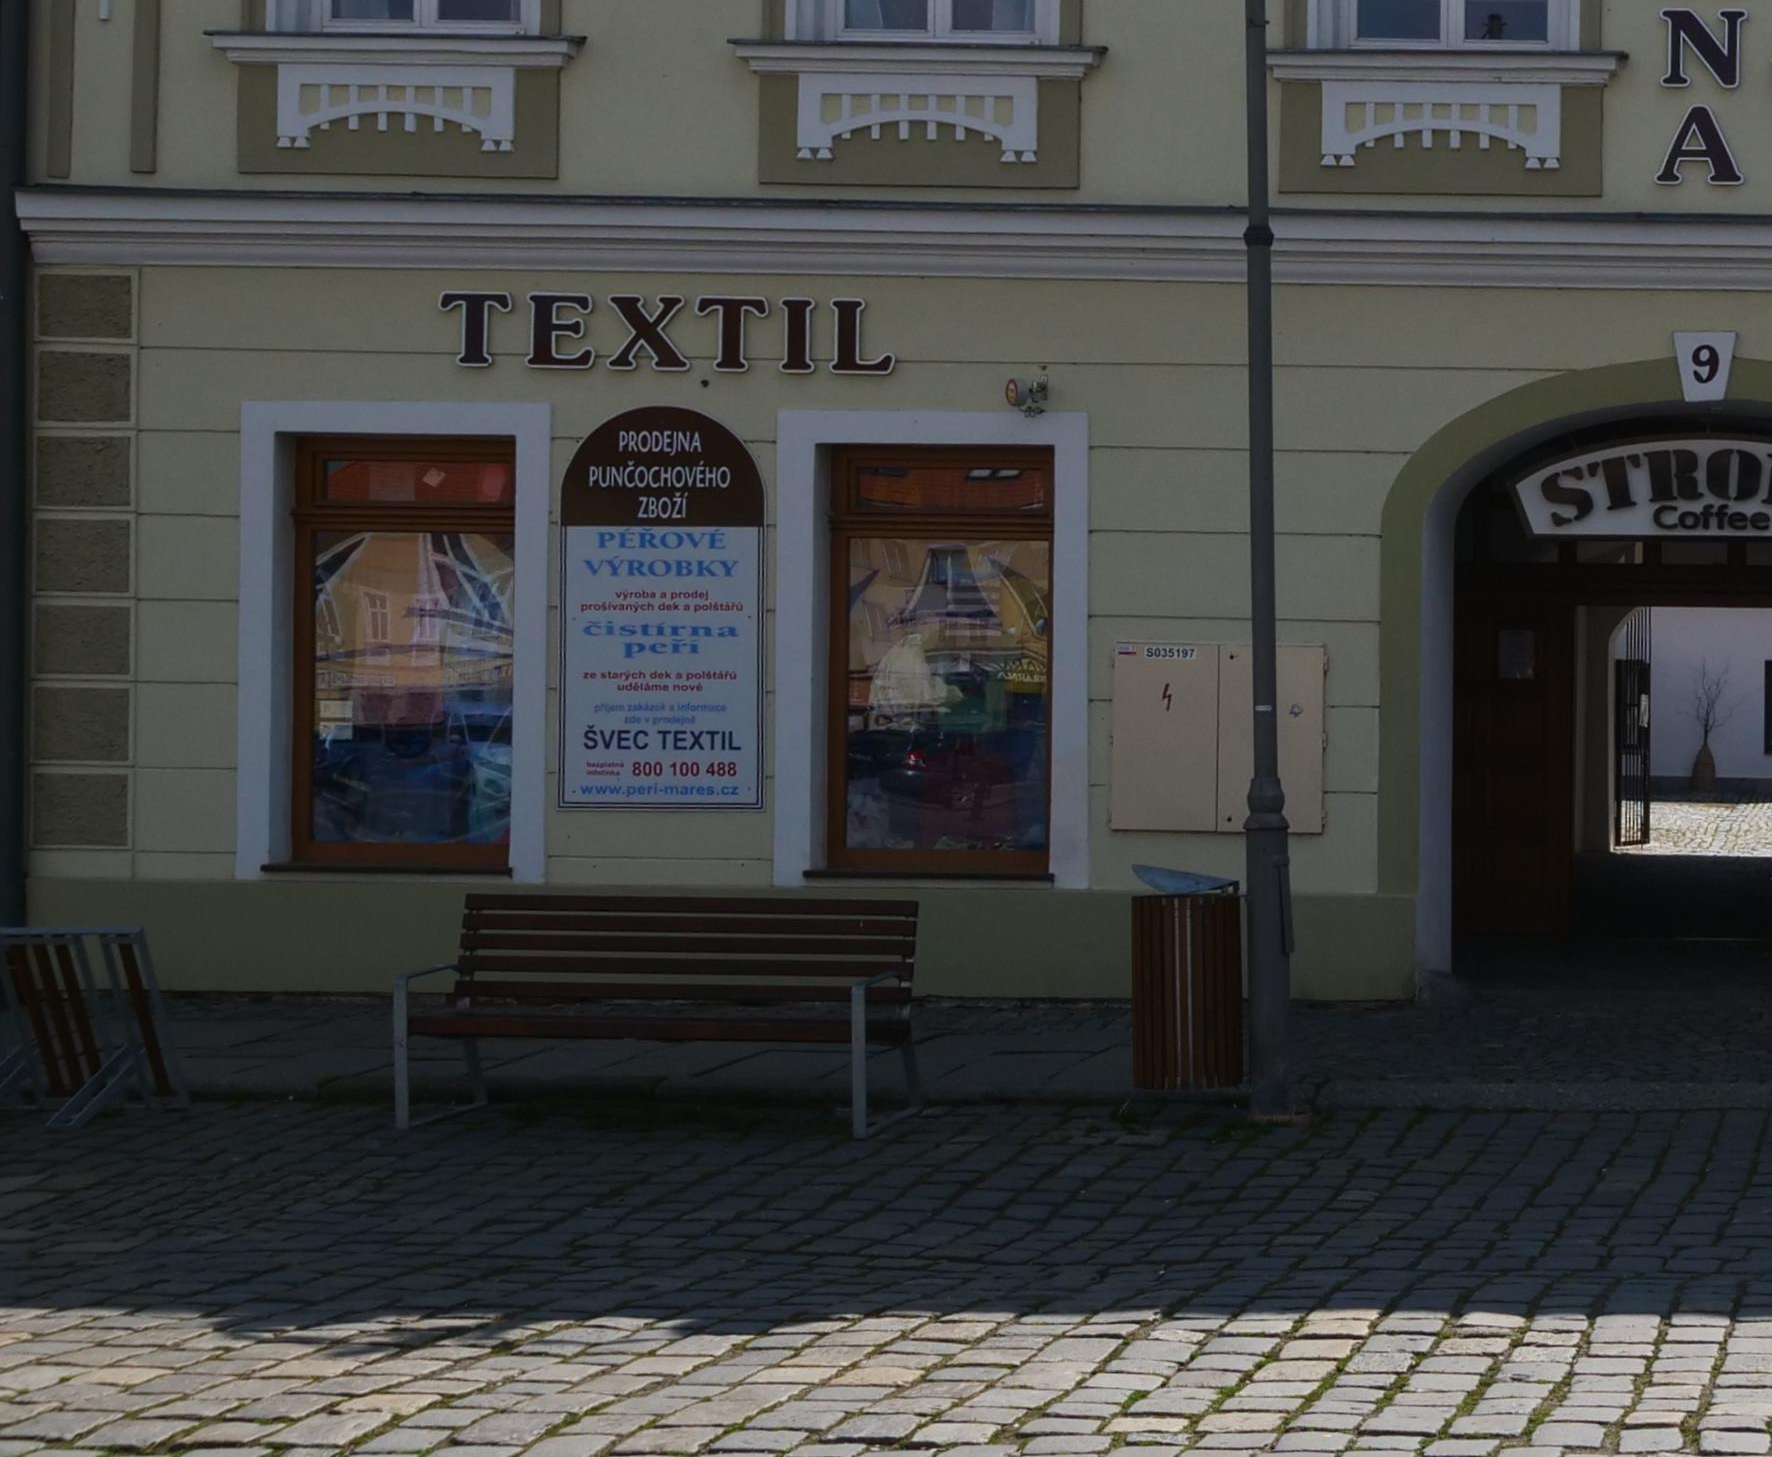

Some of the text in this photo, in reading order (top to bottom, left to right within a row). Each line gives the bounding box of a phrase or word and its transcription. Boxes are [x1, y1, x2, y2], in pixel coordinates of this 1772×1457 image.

[438, 290, 896, 376] TEXTIL
[1691, 343, 1720, 385] 9
[618, 430, 702, 457] PRODEJNA
[588, 461, 731, 488] PUNČOCHOVÉHO
[637, 493, 687, 519] ZBOŽÍ
[1653, 503, 1771, 532] Coffee
[596, 528, 727, 550] PÉŘOVÉ
[582, 555, 739, 578] VÝROBKY
[615, 589, 656, 601] výroba
[671, 589, 709, 601] prodej
[580, 601, 654, 614] prošívaných
[658, 602, 680, 612] dek
[693, 601, 743, 614] polštářů
[582, 620, 739, 638] čistírna
[624, 638, 700, 659] peří
[1146, 647, 1195, 659] S035197
[583, 672, 597, 680] ze
[600, 670, 646, 682] starých
[649, 670, 672, 680] dek
[686, 669, 737, 682] polštářů
[617, 681, 703, 692] uděláme nové
[583, 725, 742, 751] ŠVEC TEXTIL
[632, 761, 737, 778] 800 100 488
